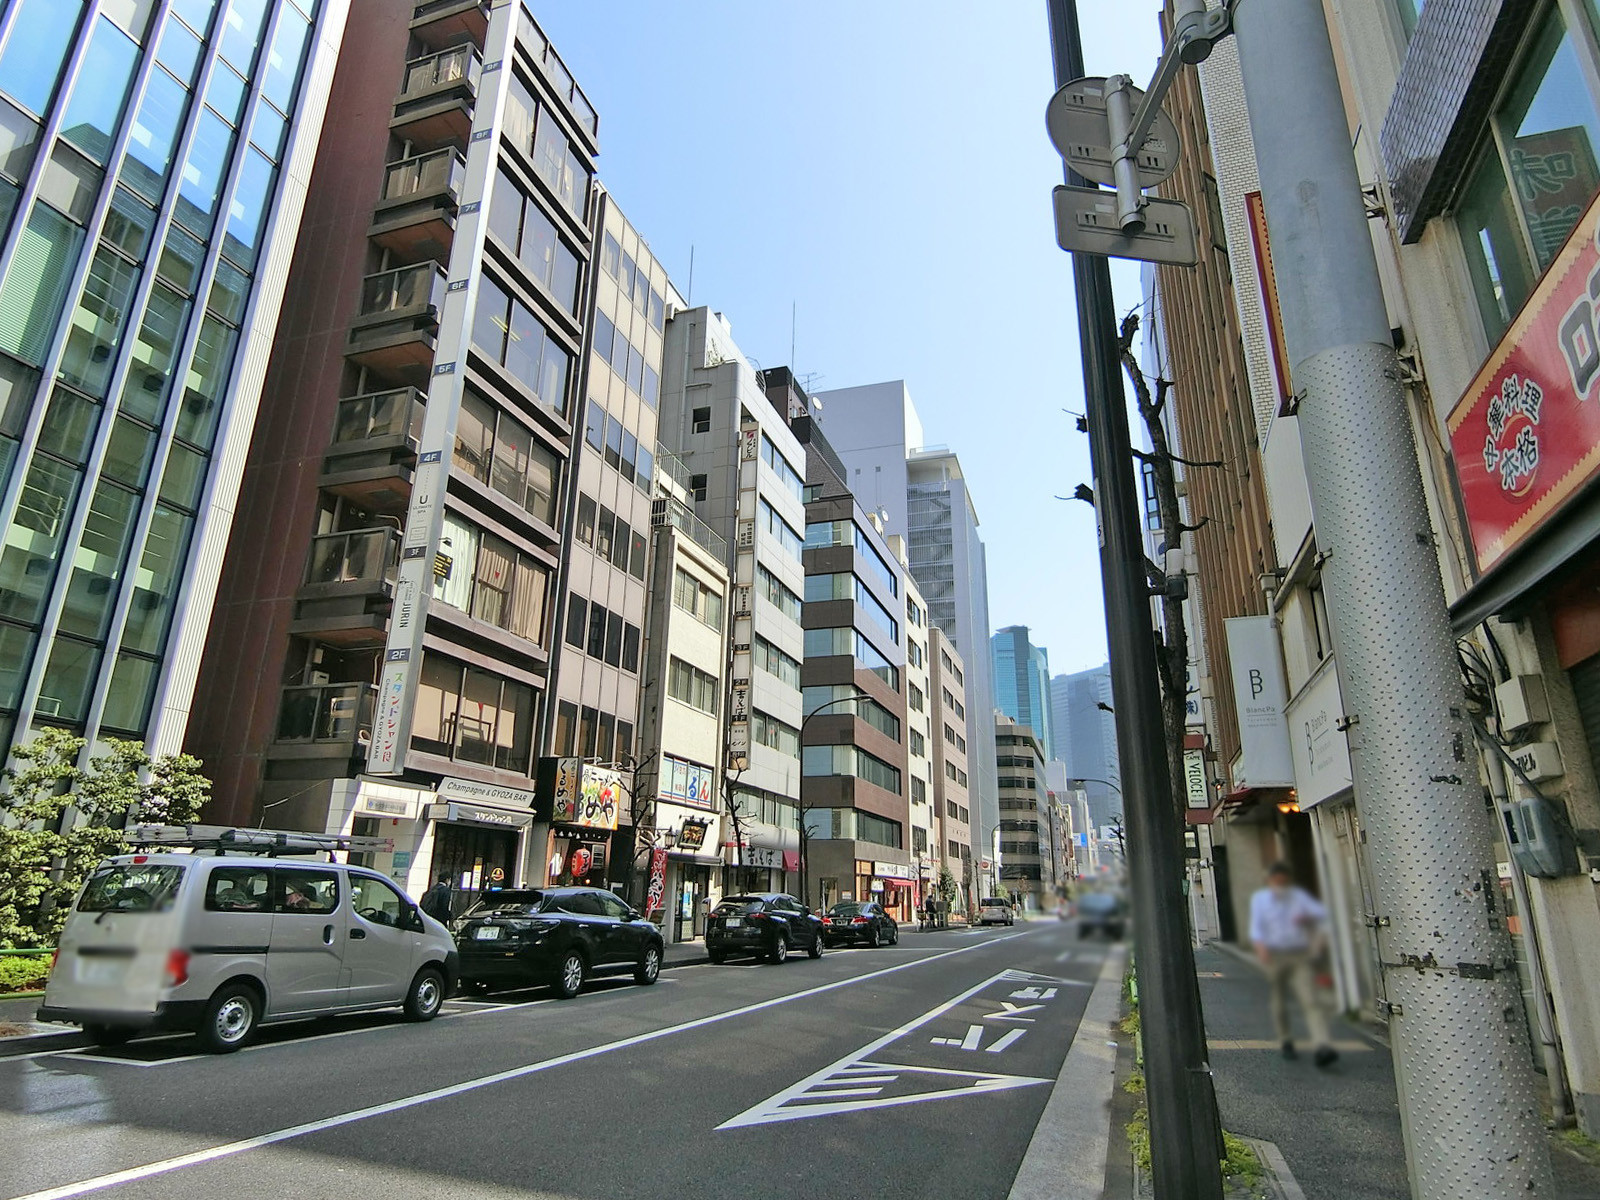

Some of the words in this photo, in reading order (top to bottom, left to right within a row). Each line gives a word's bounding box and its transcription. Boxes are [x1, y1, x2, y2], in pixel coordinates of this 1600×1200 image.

[464, 203, 477, 212] 7F
[438, 364, 452, 374] 5F
[423, 453, 438, 463] 4F
[1502, 429, 1538, 487] 本格
[399, 602, 412, 628] JURIN
[391, 650, 406, 660] 2F
[556, 759, 569, 813] くるめや
[1188, 762, 1204, 793] VELOCE
[446, 781, 486, 796] Champagne
[491, 788, 514, 799] GYOZA
[513, 793, 529, 803] BAR
